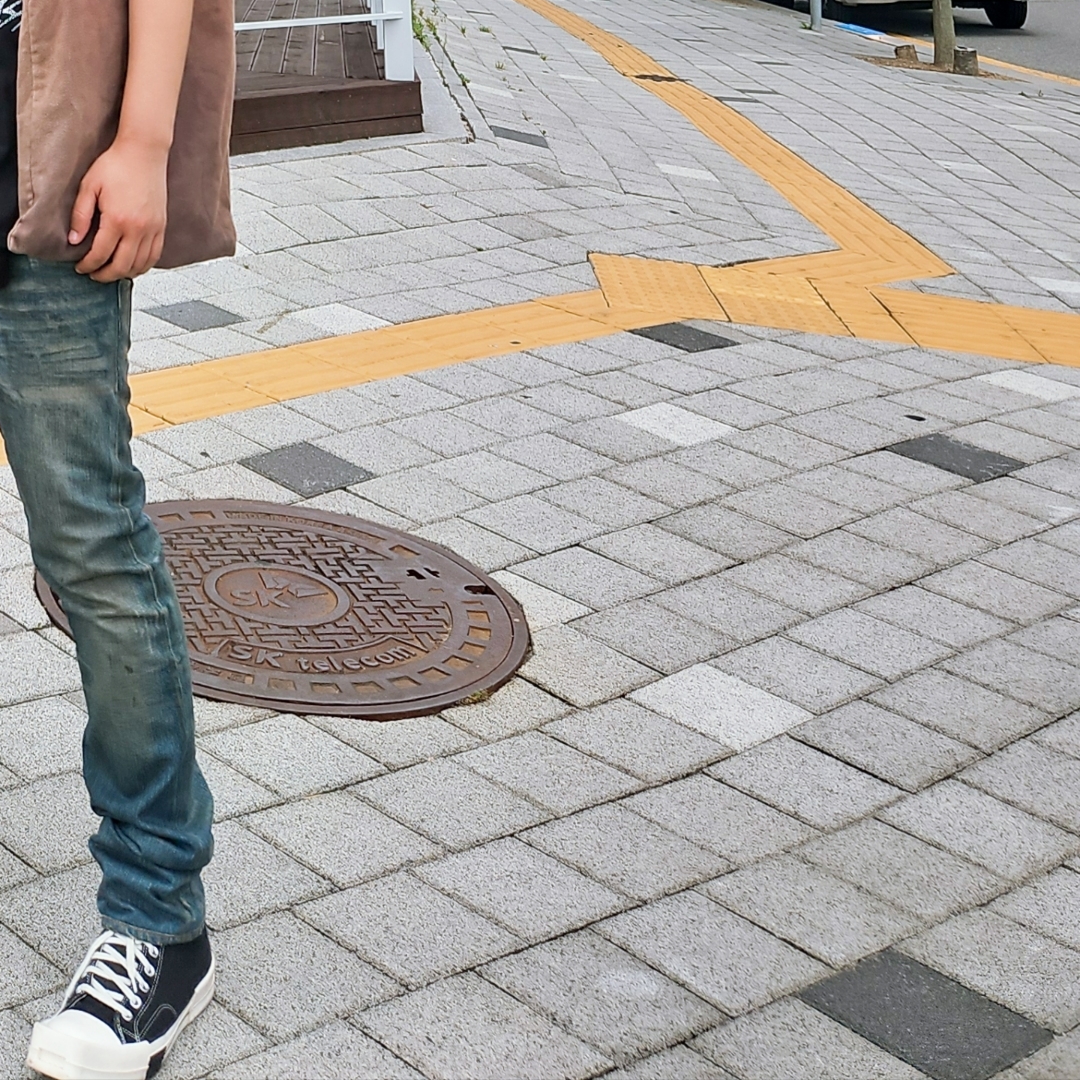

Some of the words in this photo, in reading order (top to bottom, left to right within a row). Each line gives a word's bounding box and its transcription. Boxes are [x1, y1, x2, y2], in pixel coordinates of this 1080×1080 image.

[229, 588, 291, 610] SK
[228, 644, 284, 668] SK
[296, 643, 417, 672] telecom
